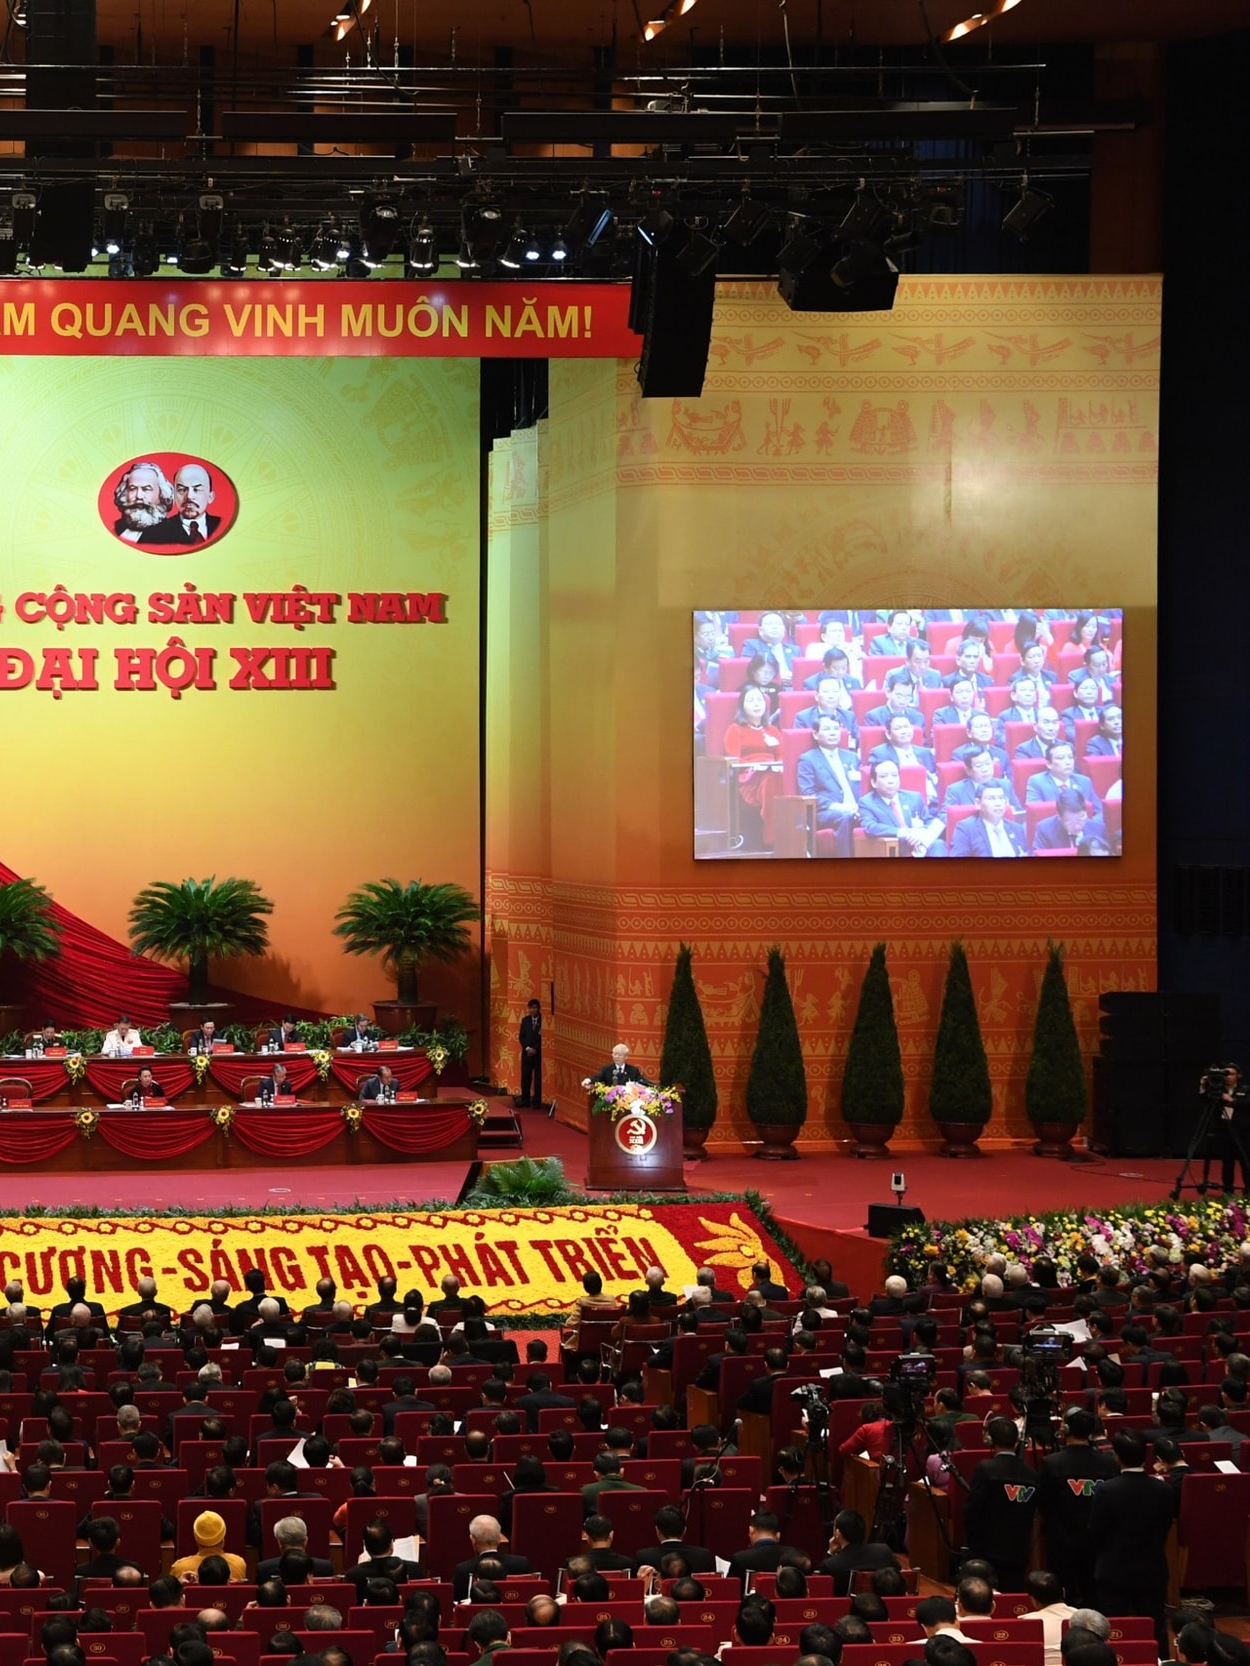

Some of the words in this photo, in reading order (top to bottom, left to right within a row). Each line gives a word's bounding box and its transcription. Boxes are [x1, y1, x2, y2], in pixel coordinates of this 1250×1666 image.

[50, 302, 210, 339] QUANG
[224, 304, 325, 337] VINH
[341, 295, 469, 338] MUÔN
[485, 297, 592, 339] NĂM!
[14, 584, 138, 631] CỘNG
[148, 582, 237, 624] SẢN
[243, 584, 340, 631] VIỆT
[347, 592, 446, 624] NAM
[113, 635, 217, 700] HỘI
[229, 646, 336, 691] XIII
[530, 1225, 669, 1284] TRIỂN
[1004, 1484, 1035, 1502] VTV
